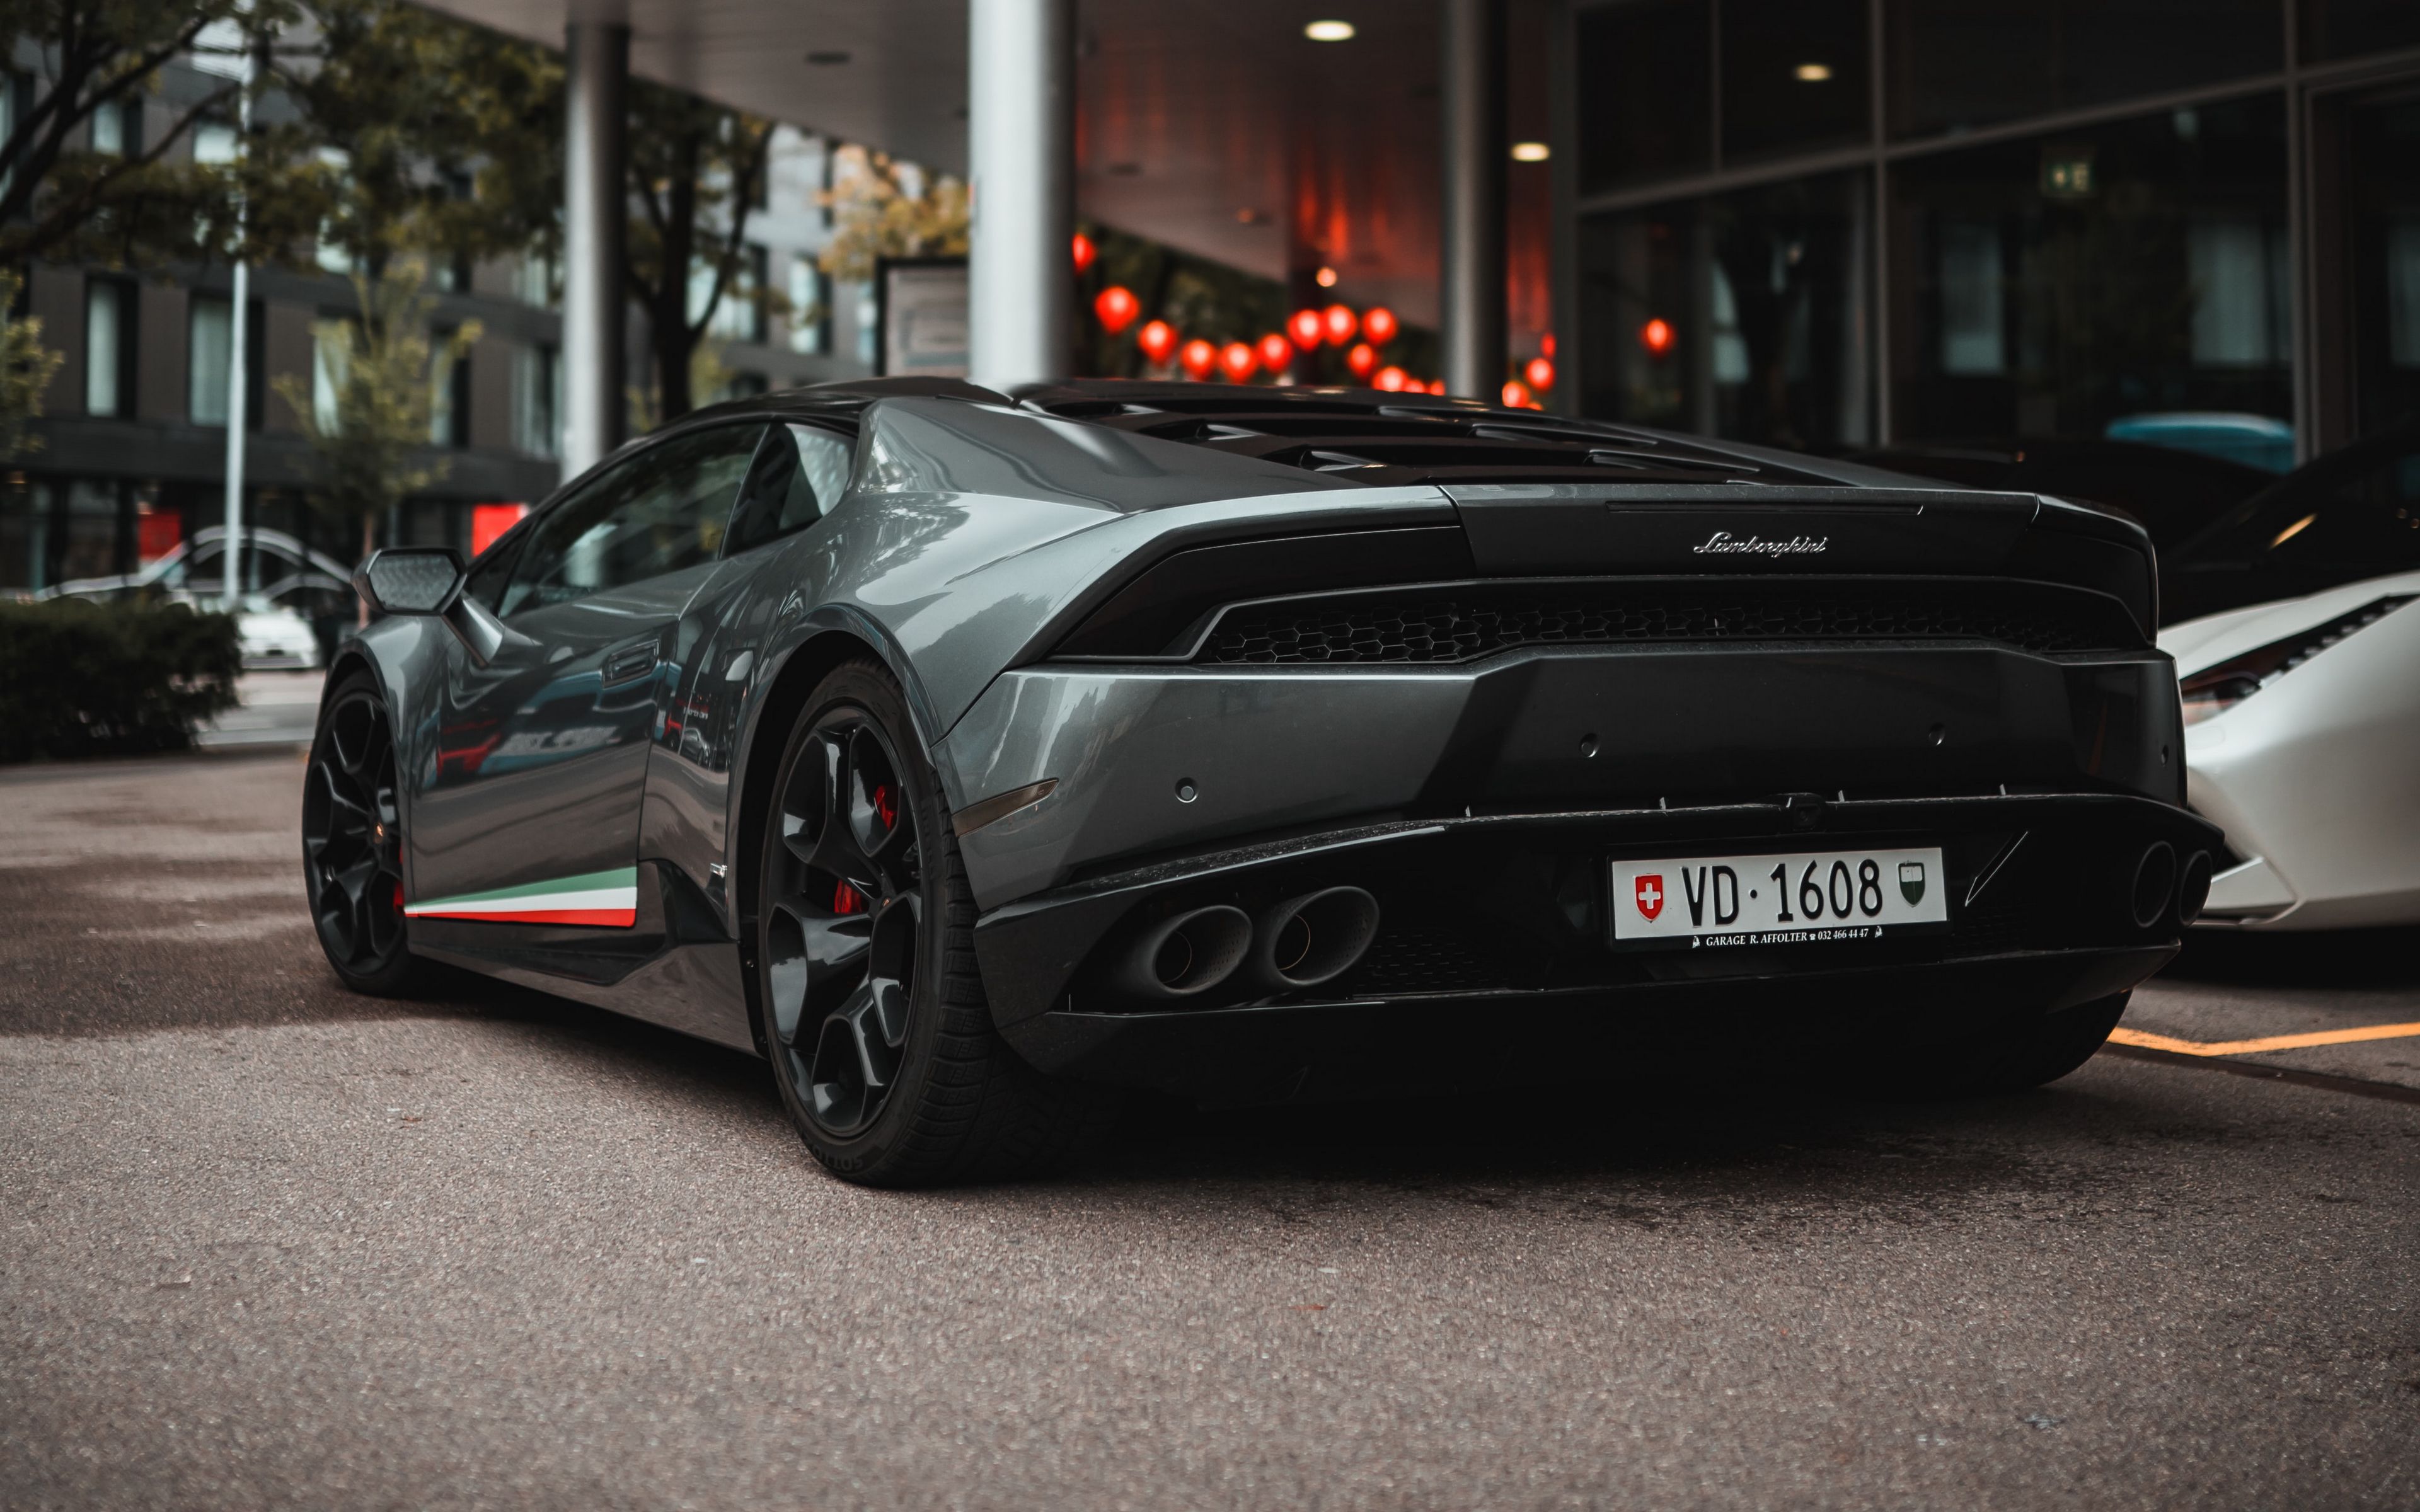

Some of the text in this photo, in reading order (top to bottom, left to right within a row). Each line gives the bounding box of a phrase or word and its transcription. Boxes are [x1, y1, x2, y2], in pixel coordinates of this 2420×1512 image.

[1693, 532, 1828, 558] Lamborghini
[1707, 929, 1869, 946] GARAGE R. AFFOLTER 032 466 44 47
